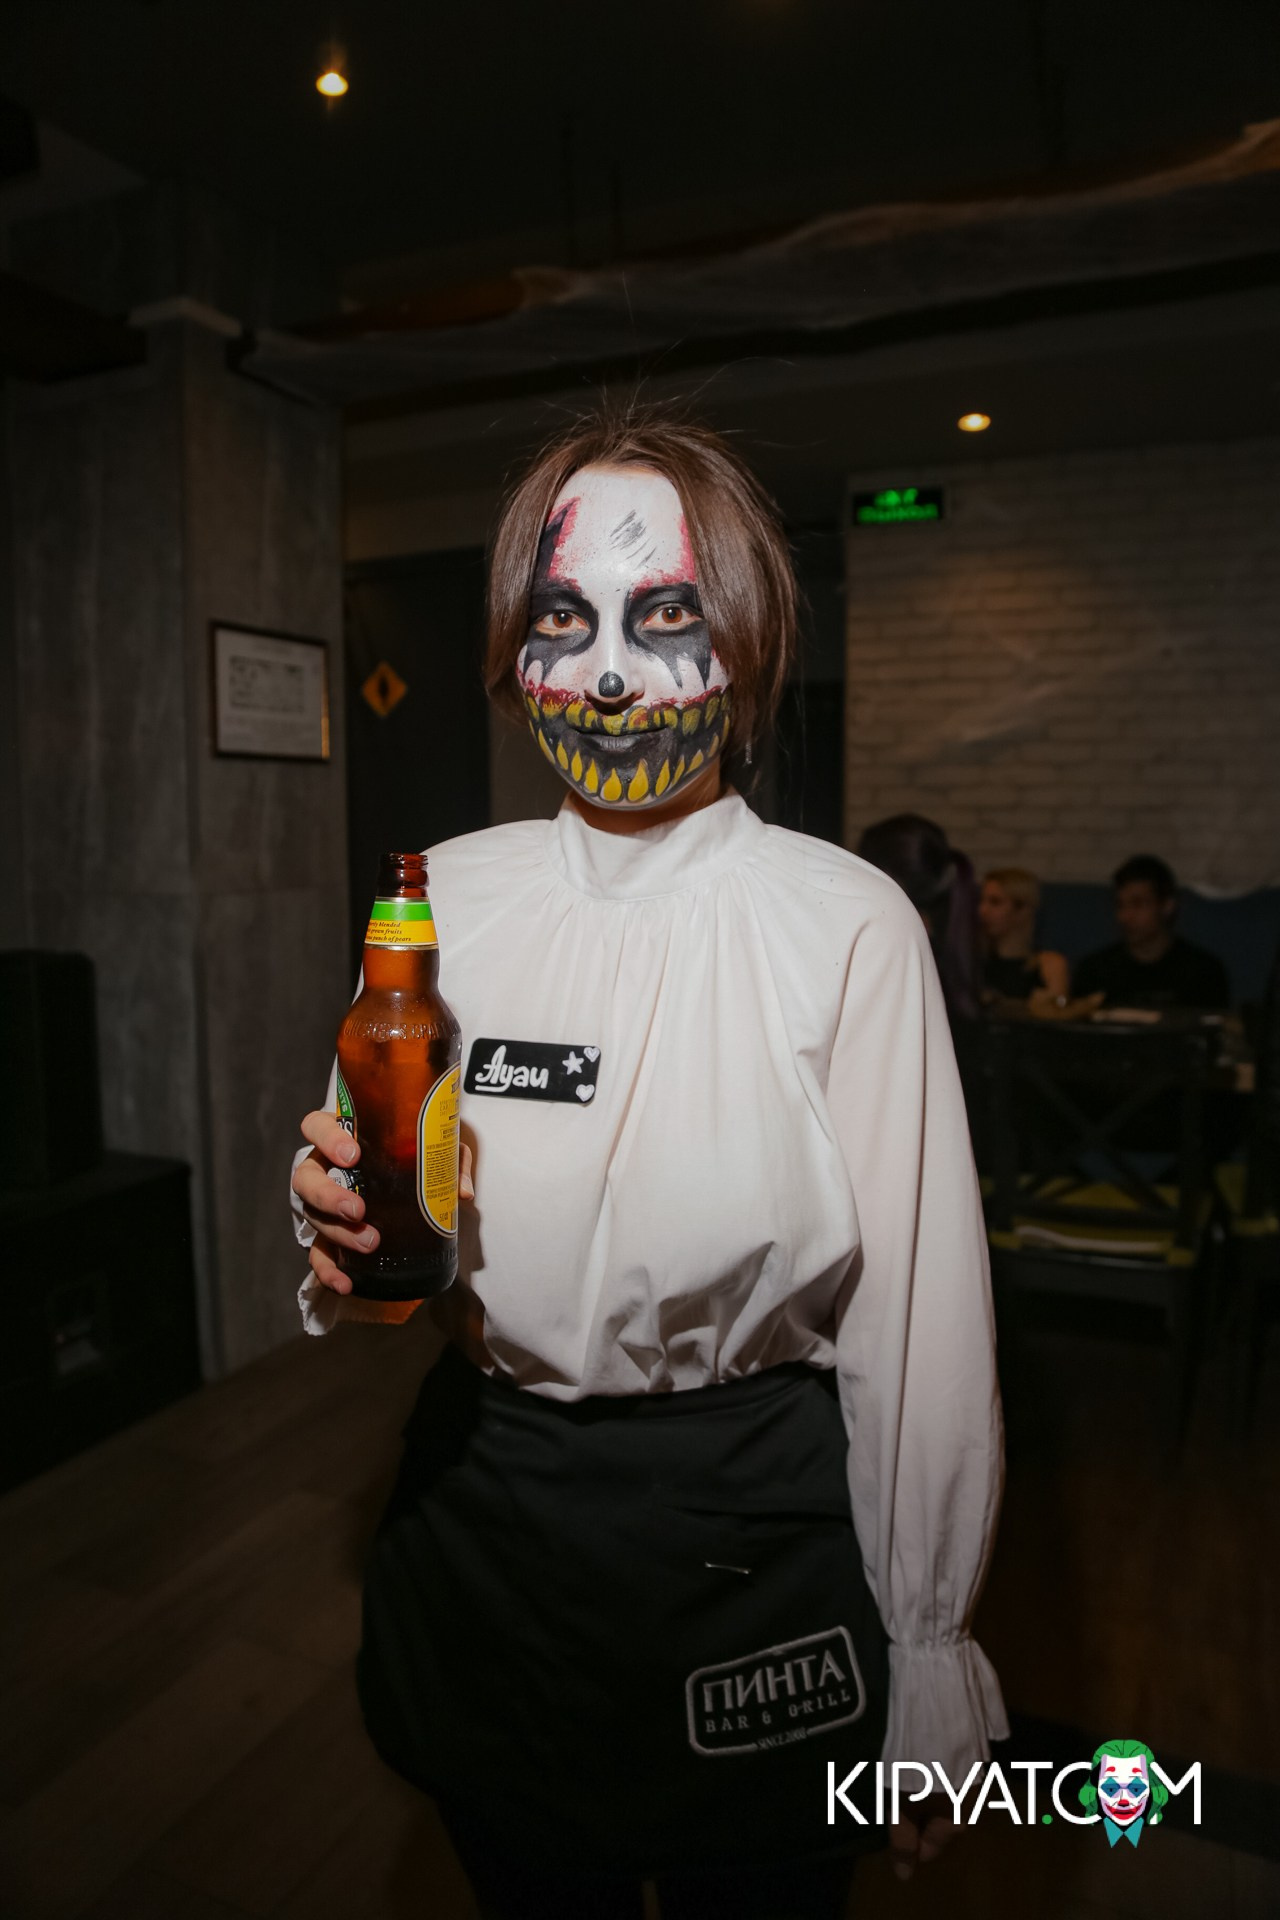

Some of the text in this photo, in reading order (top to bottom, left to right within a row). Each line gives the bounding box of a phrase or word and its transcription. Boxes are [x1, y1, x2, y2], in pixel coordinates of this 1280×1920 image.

[702, 1649, 847, 1713] ПИНТА
[705, 1688, 851, 1733] BAR & GRILL
